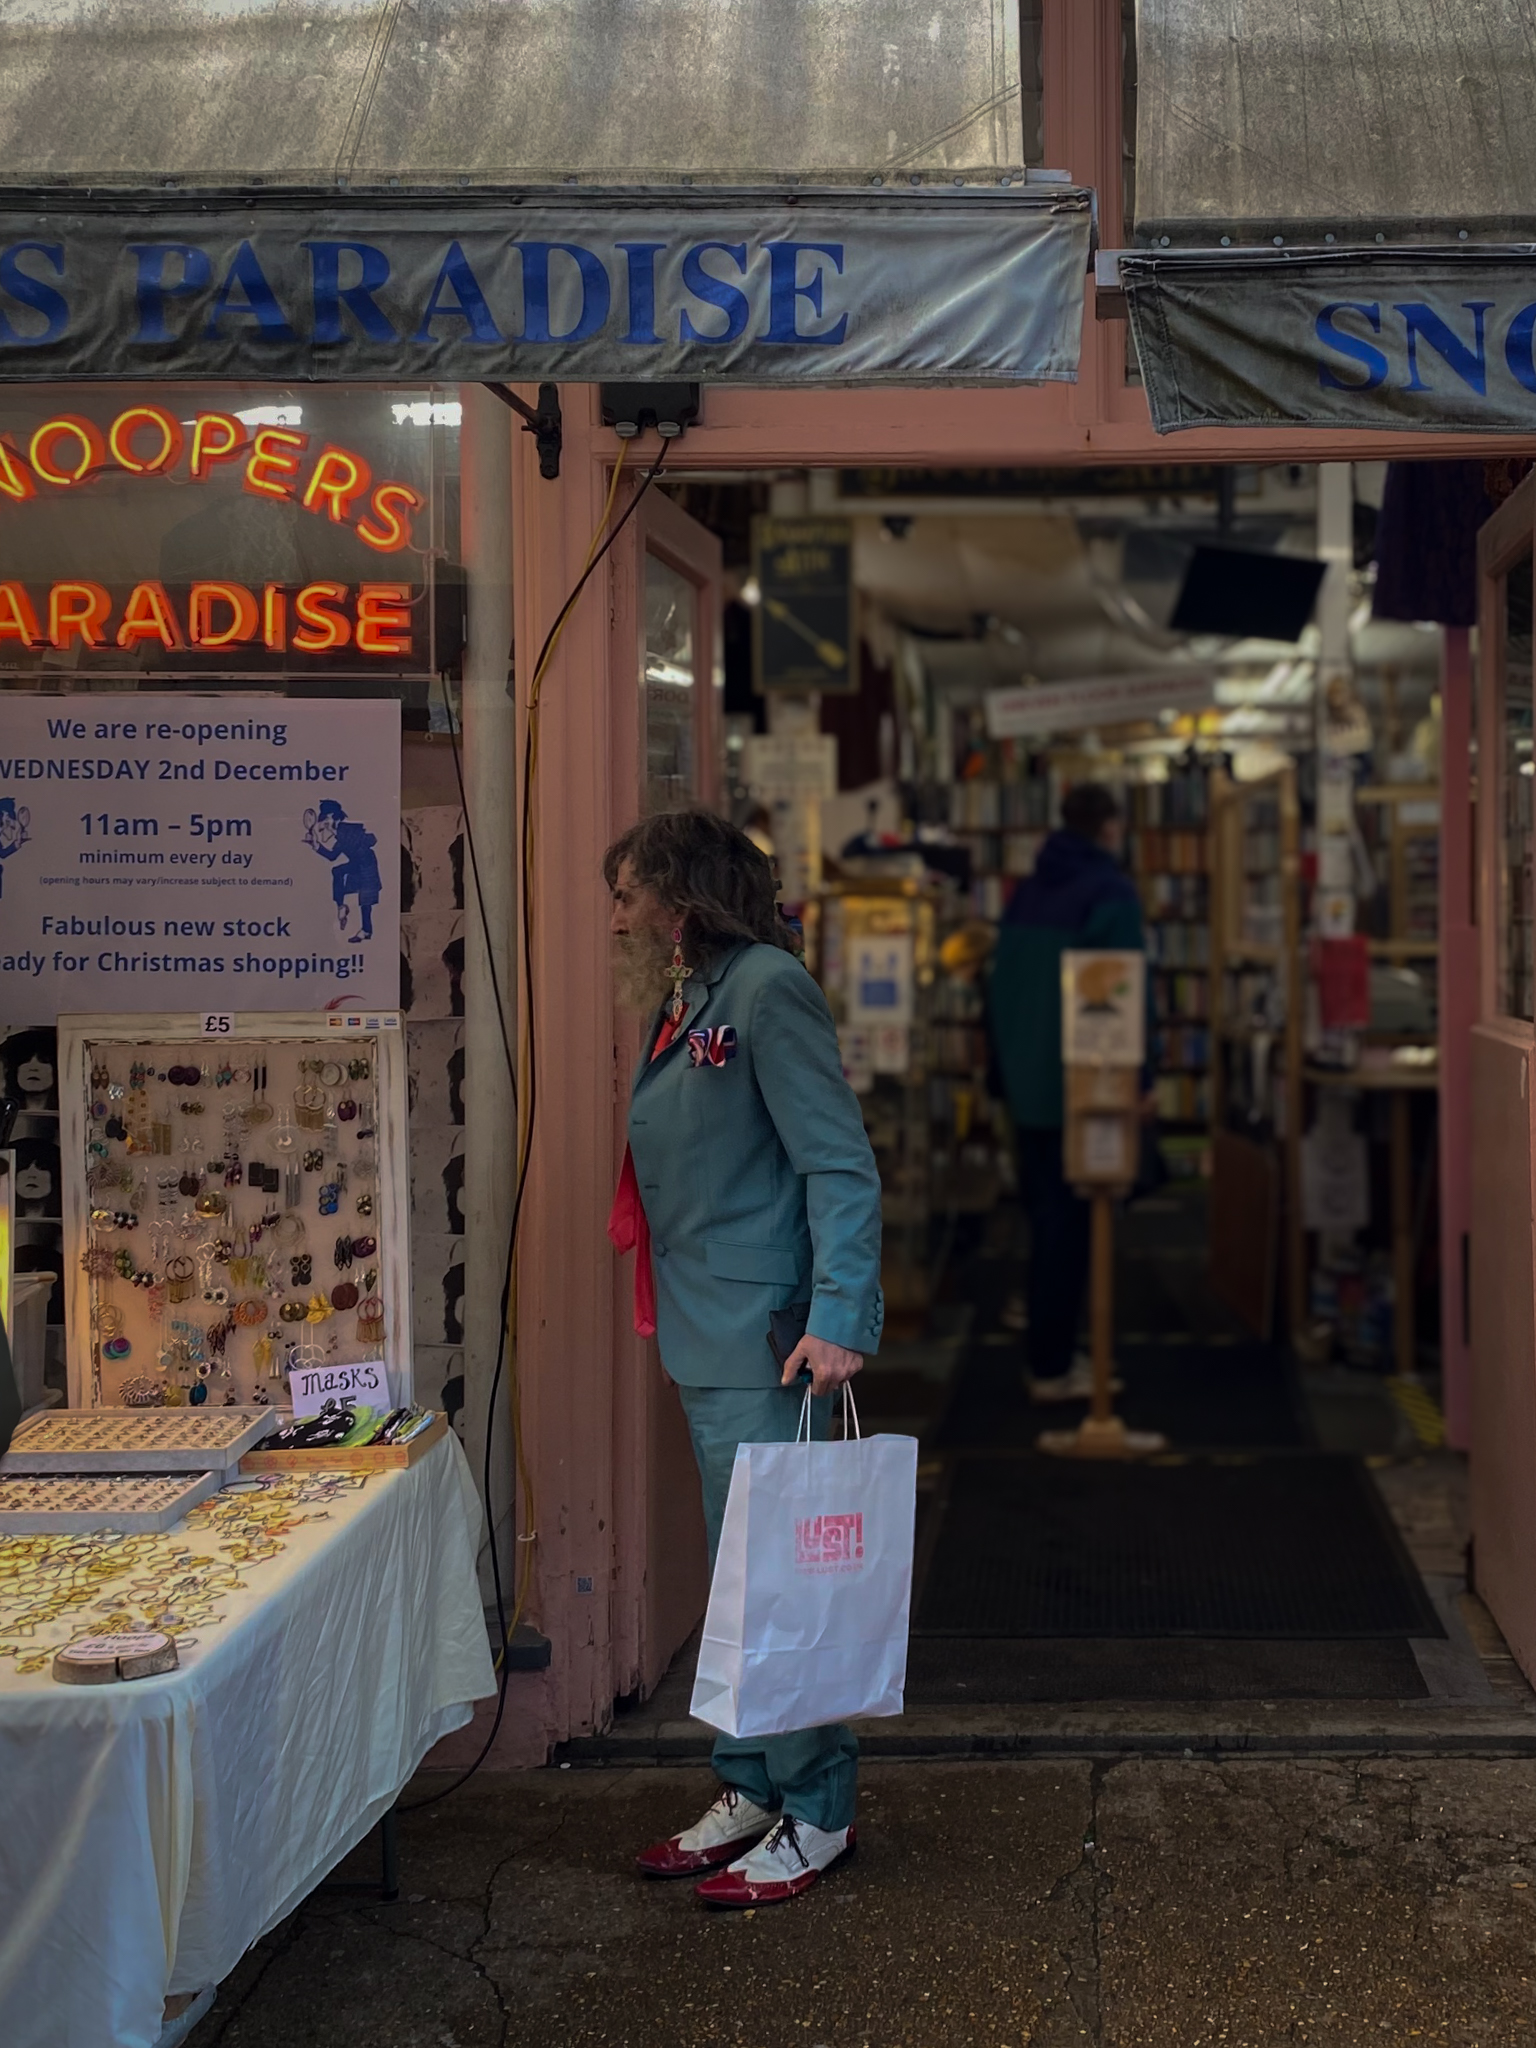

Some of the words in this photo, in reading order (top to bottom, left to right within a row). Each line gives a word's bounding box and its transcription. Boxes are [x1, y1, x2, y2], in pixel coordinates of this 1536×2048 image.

[125, 236, 849, 346] PARADISE
[47, 718, 86, 739] We
[94, 723, 137, 739] are
[146, 719, 288, 746] re-opening
[158, 760, 205, 780] 2nd
[214, 760, 349, 781] December
[80, 813, 159, 836] 11am
[190, 814, 253, 843] 5pm
[79, 850, 165, 865] minimum
[169, 852, 216, 868] every
[221, 850, 253, 869] day
[39, 876, 81, 887] (opening
[82, 876, 110, 886] hours
[112, 877, 134, 887] may
[135, 876, 199, 887] vary/increase
[201, 877, 236, 888] subject
[238, 878, 249, 886] to
[251, 877, 293, 887] demand)
[41, 916, 156, 937] Fabulous
[164, 920, 214, 937] new
[222, 916, 291, 937] stock
[0, 951, 46, 977] ady
[52, 951, 90, 972] for
[97, 952, 225, 973] Christmas
[233, 953, 365, 979] shopping!!
[205, 1015, 231, 1033] £5
